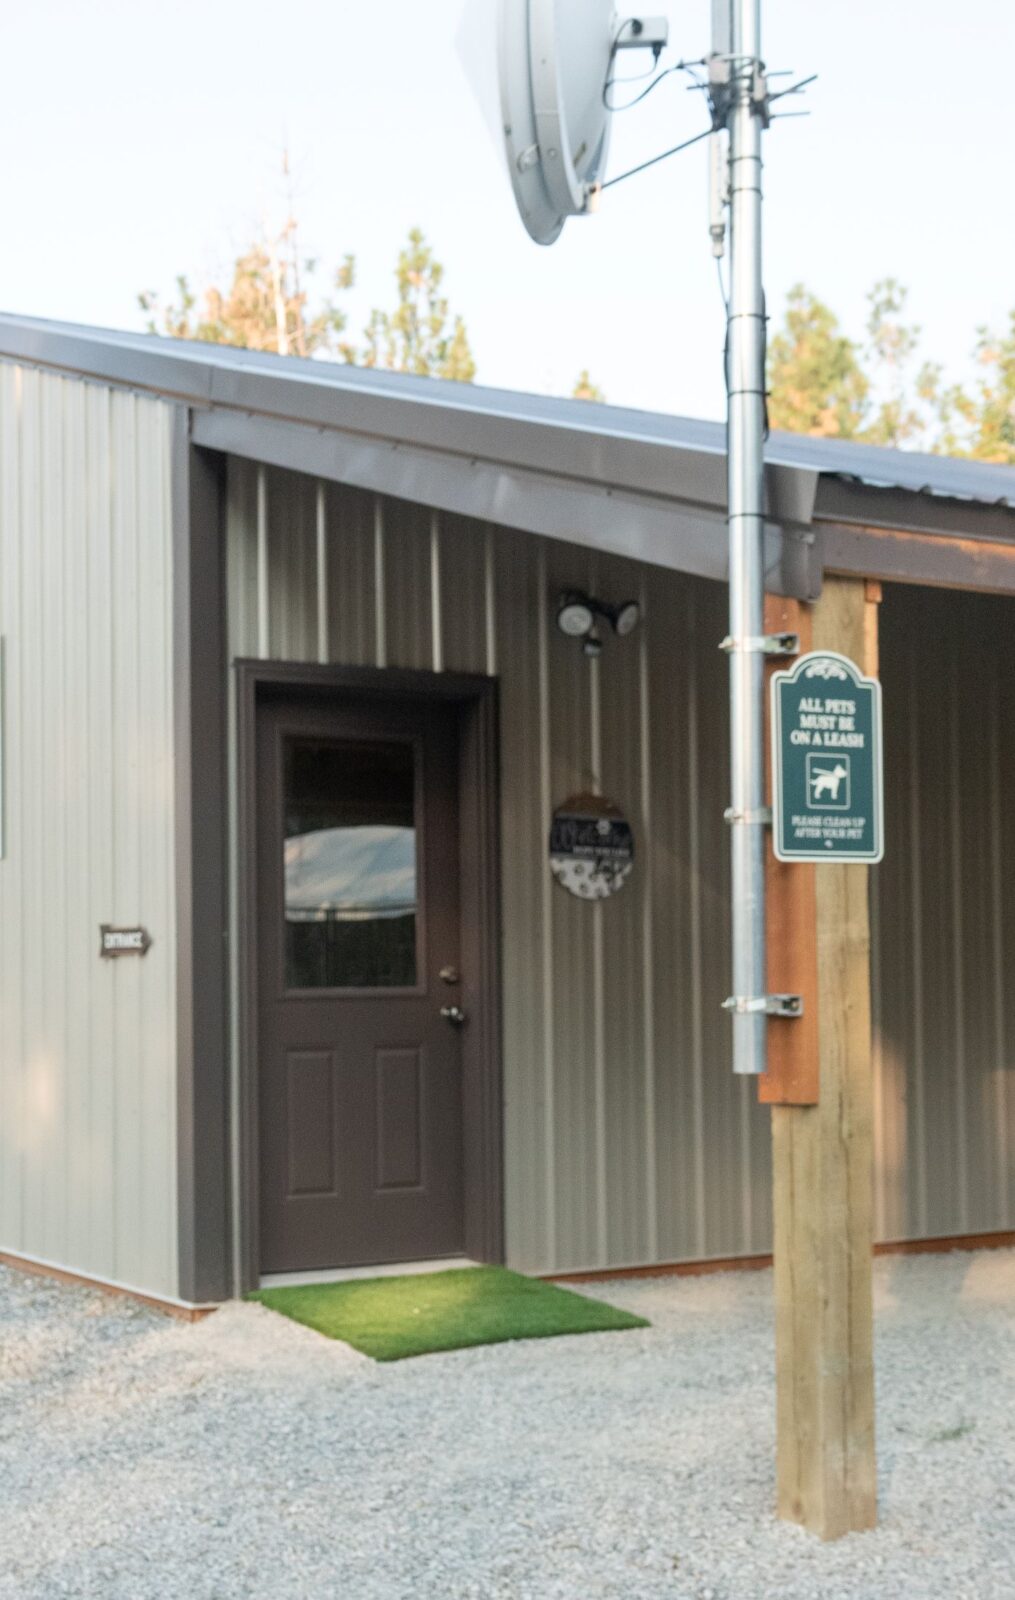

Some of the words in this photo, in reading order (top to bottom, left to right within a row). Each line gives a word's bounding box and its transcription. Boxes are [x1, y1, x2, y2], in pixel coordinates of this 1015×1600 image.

[799, 697, 824, 713] ALL
[824, 698, 856, 715] PETS
[800, 713, 837, 730] MUST
[838, 715, 856, 731] BE
[790, 729, 811, 745] ON
[812, 731, 823, 746] A
[823, 731, 865, 748] LEASH
